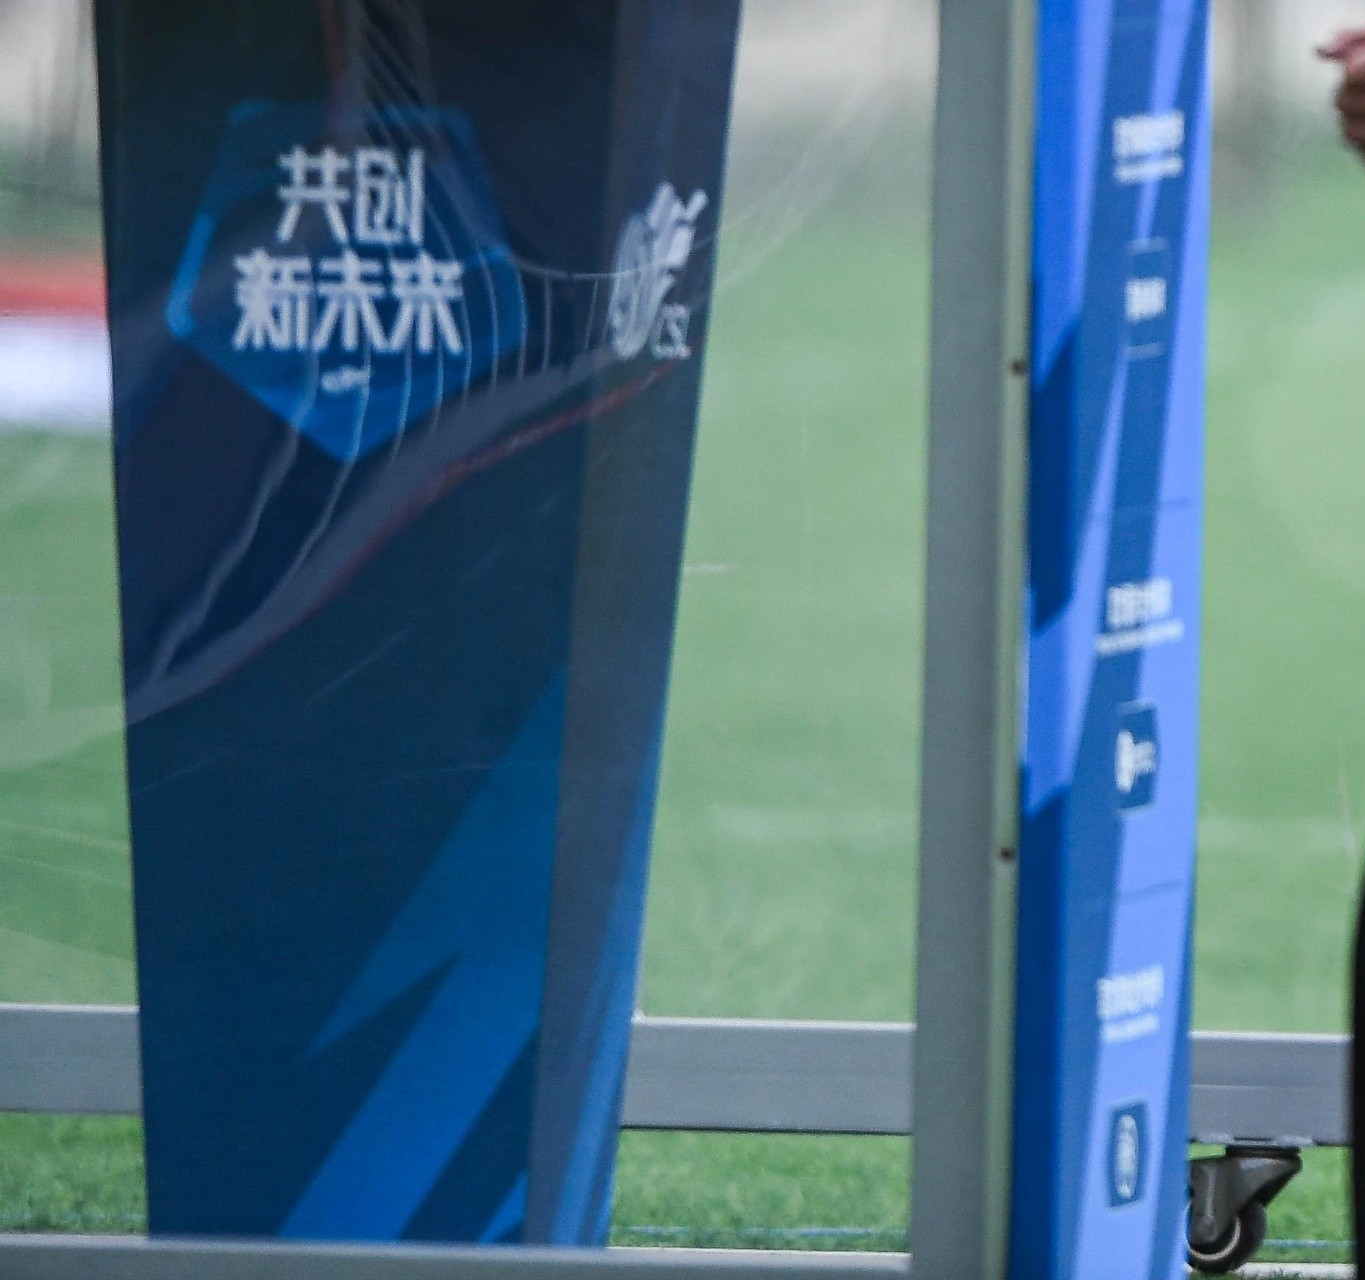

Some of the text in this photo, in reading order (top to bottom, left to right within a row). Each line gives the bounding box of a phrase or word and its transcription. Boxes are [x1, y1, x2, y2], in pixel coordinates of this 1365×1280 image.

[276, 146, 426, 245] 共创
[232, 248, 465, 353] 新未来
